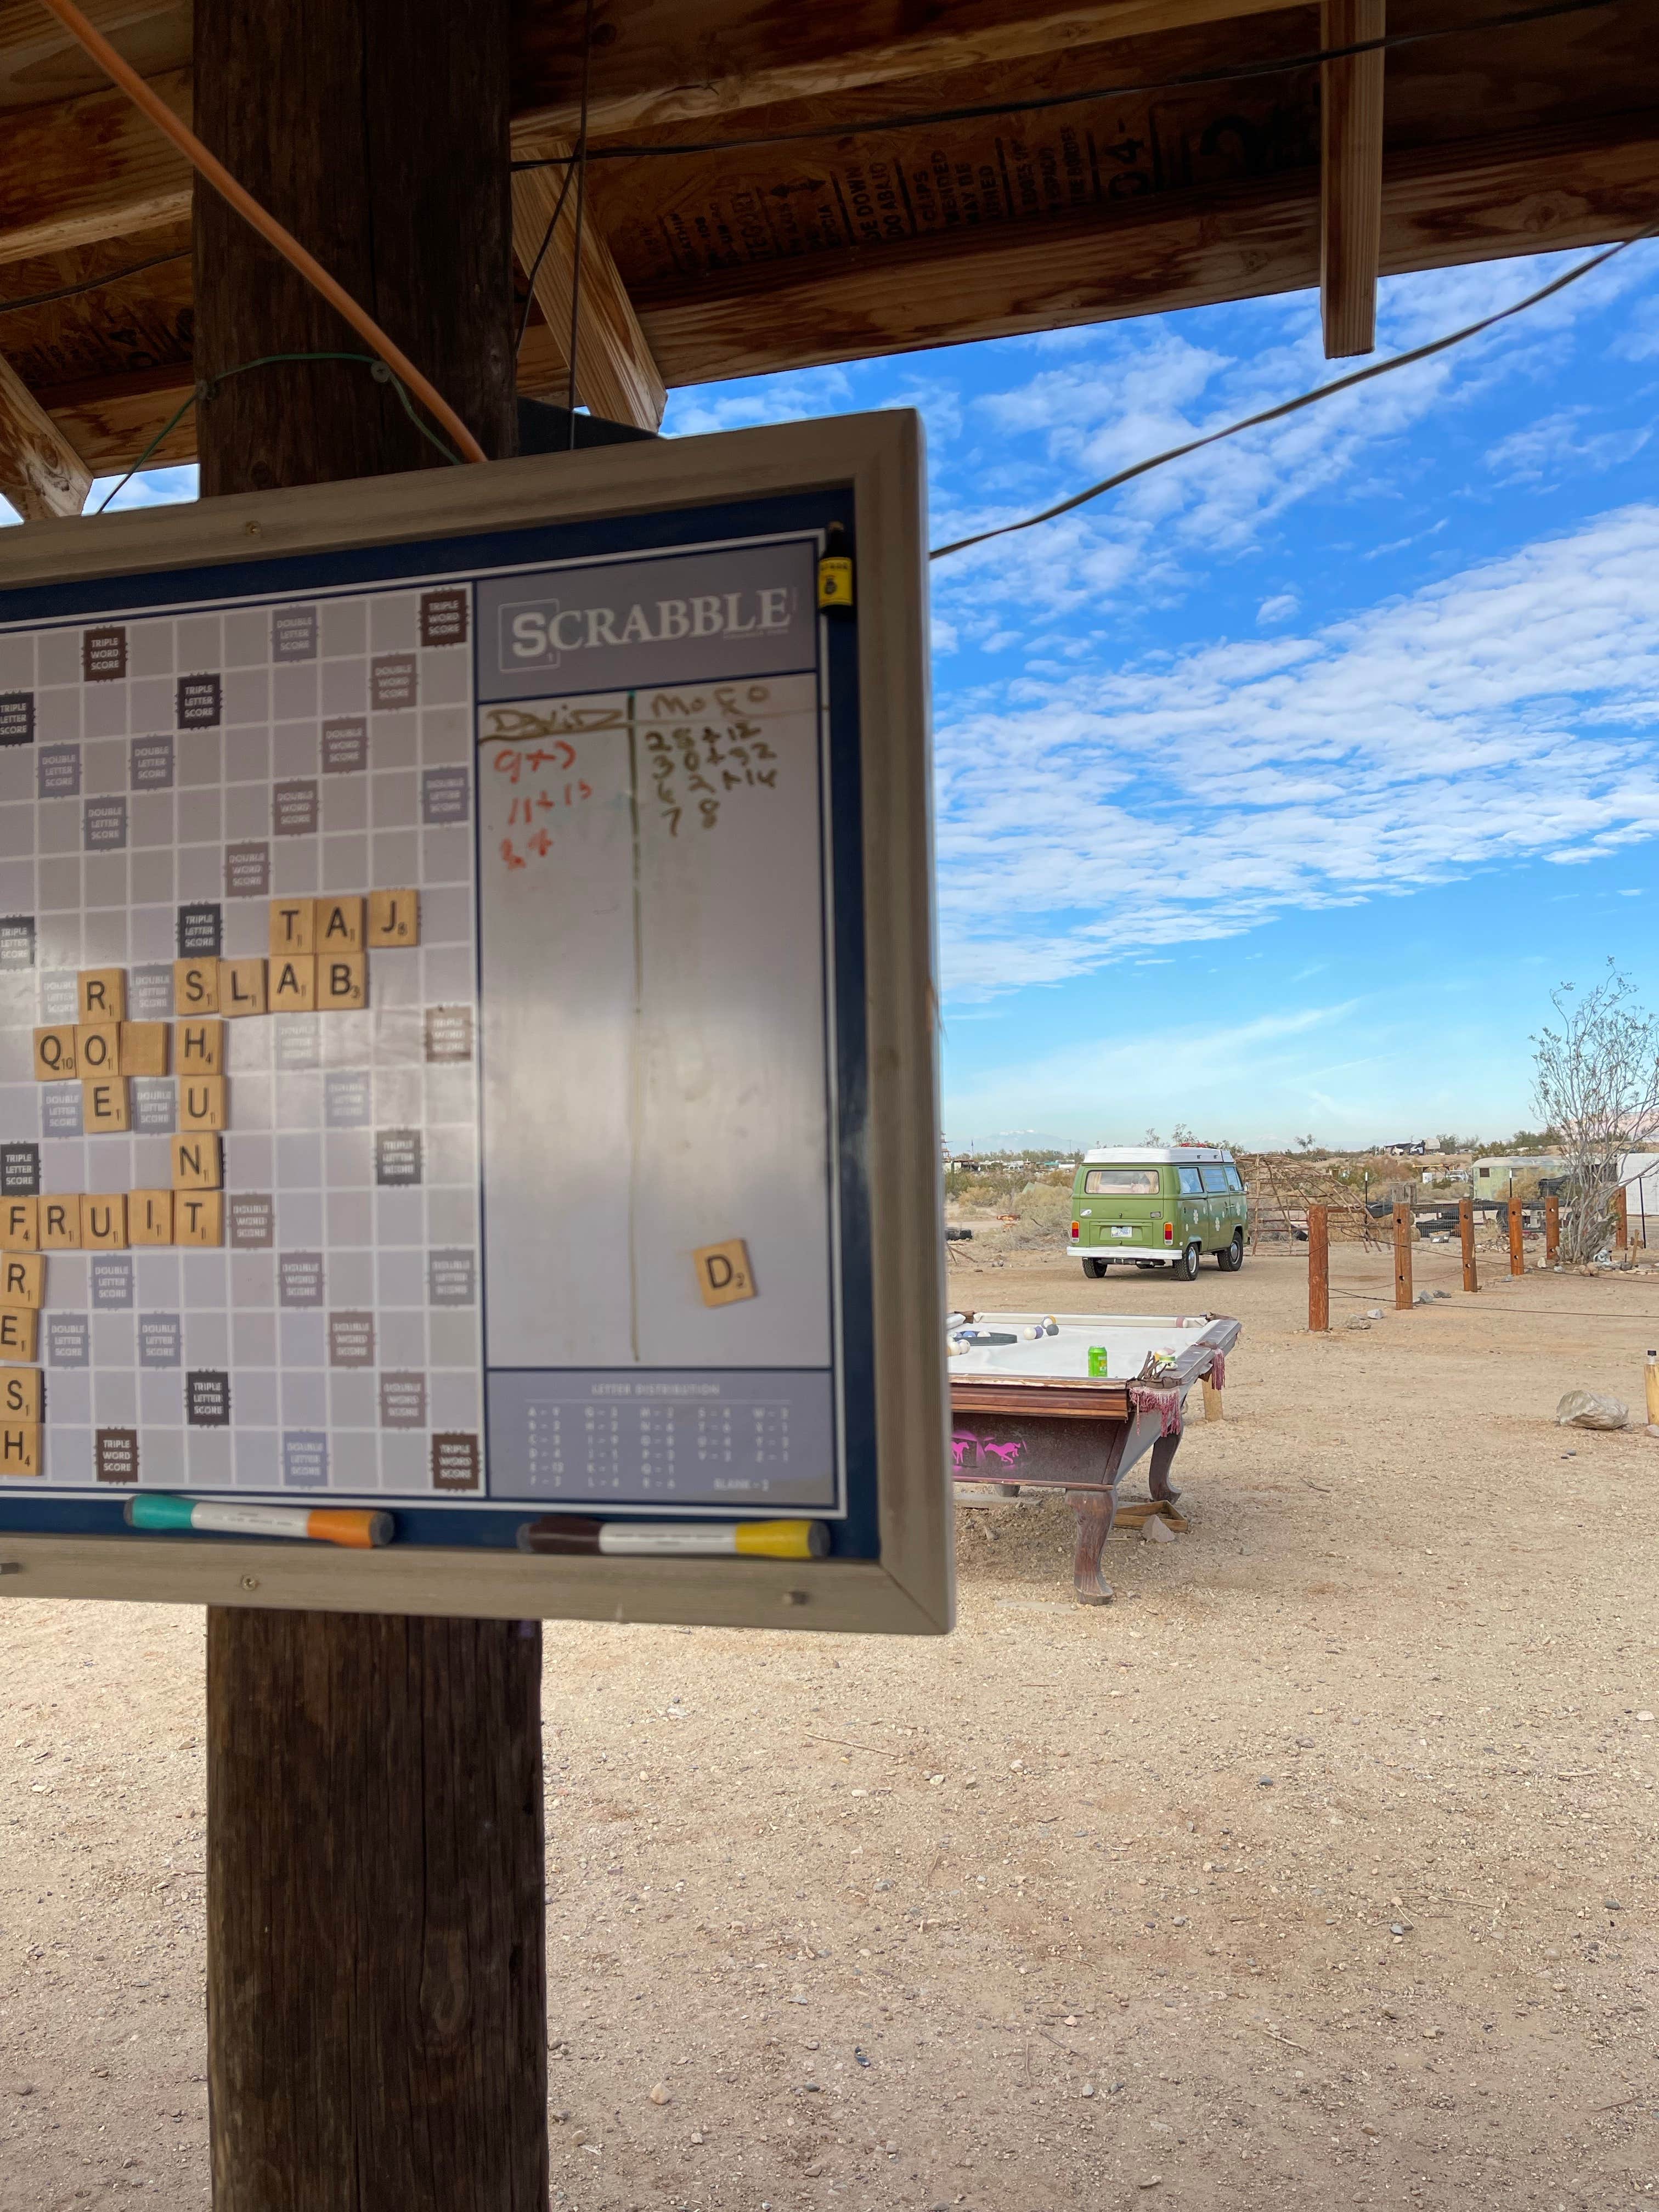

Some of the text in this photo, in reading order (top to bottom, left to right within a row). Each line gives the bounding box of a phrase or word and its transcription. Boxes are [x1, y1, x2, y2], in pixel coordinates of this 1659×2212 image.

[843, 163, 873, 219] DOWN
[429, 600, 458, 611] TRIPLE
[276, 617, 312, 629] DOUBLE
[428, 612, 459, 624] WORD
[512, 588, 791, 657] SCRABBLE
[280, 629, 309, 640] LETTER
[429, 624, 459, 636] SCORE
[92, 637, 118, 647] TRIPLE
[281, 641, 309, 652] SCORE
[91, 648, 119, 659] WORD
[91, 661, 119, 671] SCORE
[376, 664, 411, 675] DOUBLE
[379, 676, 409, 687] WORD
[185, 685, 212, 695] TRIPLE
[379, 689, 408, 699] SCORE
[185, 696, 213, 707] LETTER
[1, 703, 26, 713] TRIPLE
[185, 708, 213, 718] SCORE
[0, 714, 26, 724] LETTER
[0, 725, 26, 735] SCORE
[326, 728, 362, 739] DOUBLE
[329, 740, 360, 751] WORD
[135, 746, 168, 757] DOUBLE
[42, 754, 75, 765] DOUBLE
[330, 752, 360, 763] SCORE
[138, 758, 166, 768] LETTER
[46, 766, 72, 776] LETTER
[138, 769, 167, 779] SCORE
[46, 777, 72, 787] SCORE
[278, 791, 313, 802] DOUBLE
[89, 807, 122, 817] DOUBLE
[281, 803, 311, 813] WORD
[92, 819, 119, 828] LETTER
[281, 815, 310, 825] SCORE
[92, 830, 119, 839] SCORE
[229, 853, 264, 863] DOUBLE
[233, 865, 262, 874] WORD
[233, 877, 261, 887] SCORE
[186, 915, 213, 924] TRIPLE
[2, 927, 26, 936] TRIPLE
[185, 926, 214, 936] LETTER
[0, 938, 27, 948] LETTER
[185, 938, 213, 947] SCORE
[1, 950, 27, 960] SCORE
[186, 963, 350, 1001] SLAB
[46, 1095, 78, 1104] DOUBLE
[137, 1091, 171, 1100] DOUBLE
[49, 1107, 77, 1115] LETTER
[140, 1103, 168, 1111] LETTER
[50, 1118, 76, 1127] SCORE
[141, 1114, 168, 1123] SCORE
[6, 1154, 31, 1162] TRIPLE
[6, 1165, 32, 1173] LETTER
[6, 1177, 32, 1185] SCORE
[9, 1200, 202, 1237] FRUIT
[95, 1266, 128, 1274] DOUBLE
[706, 1254, 733, 1289] D
[99, 1278, 127, 1286] LETTER
[99, 1289, 126, 1297] SCORE
[52, 1325, 84, 1333] DOUBLE
[143, 1324, 176, 1333] DOUBLE
[55, 1336, 81, 1345] LETTER
[146, 1336, 174, 1345] LETTER
[55, 1348, 82, 1357] SCORE
[146, 1348, 174, 1356] SCORE
[194, 1382, 221, 1390] TRIPLE
[194, 1394, 222, 1402] LETTER
[194, 1406, 222, 1414] SCORE
[104, 1438, 129, 1448] TRIPLE
[440, 1443, 470, 1453] TRIPLE
[103, 1451, 131, 1460] WORD
[439, 1457, 472, 1466] WORD
[104, 1463, 131, 1472] SCORE
[441, 1469, 471, 1479] SCORE
